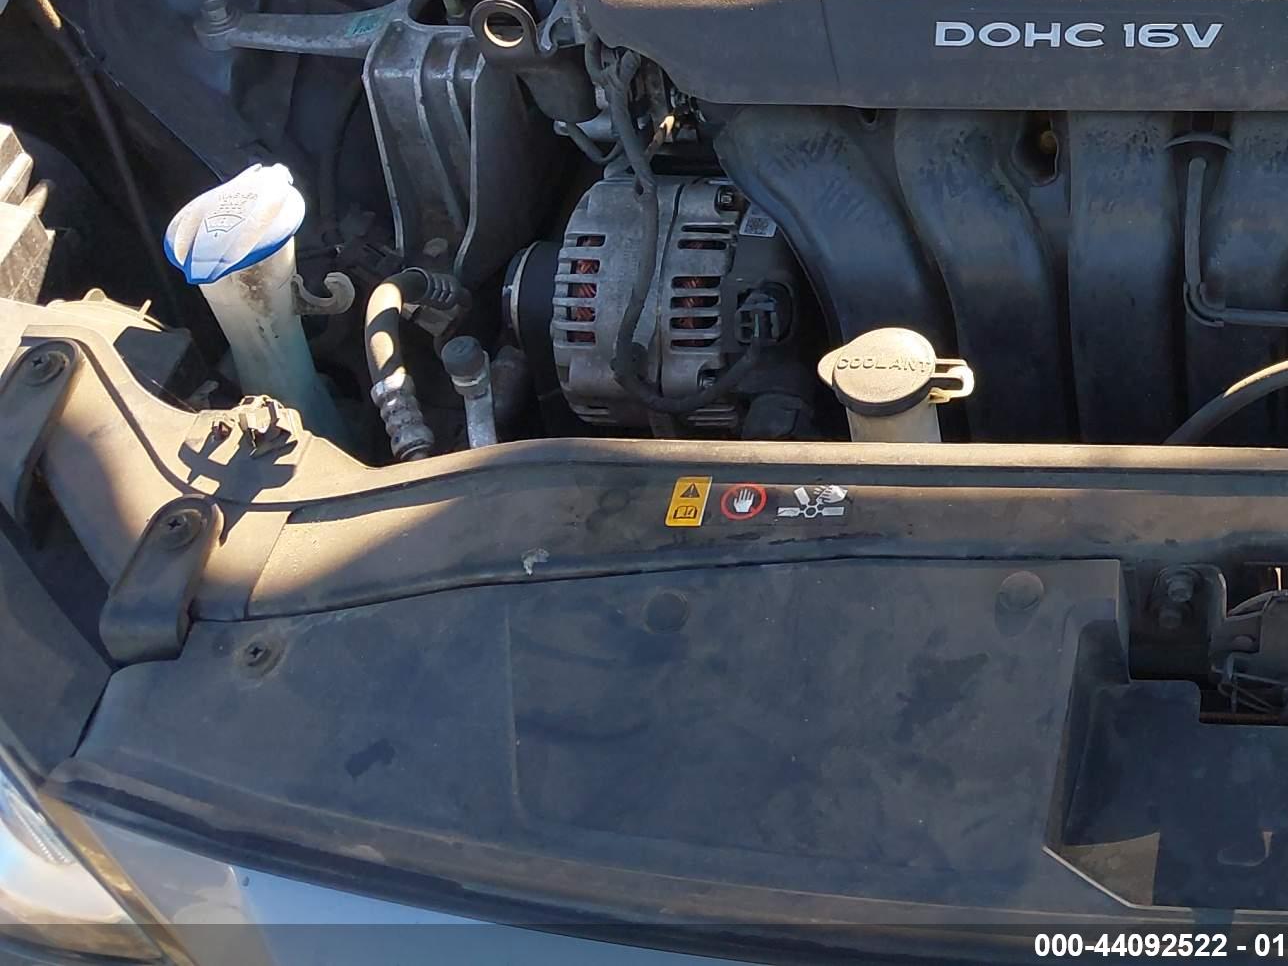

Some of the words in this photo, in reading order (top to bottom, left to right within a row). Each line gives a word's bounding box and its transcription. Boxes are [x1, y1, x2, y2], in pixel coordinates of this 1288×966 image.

[934, 21, 1104, 48] DOHC
[1123, 23, 1223, 49] 16V
[836, 357, 931, 372] COOLANT
